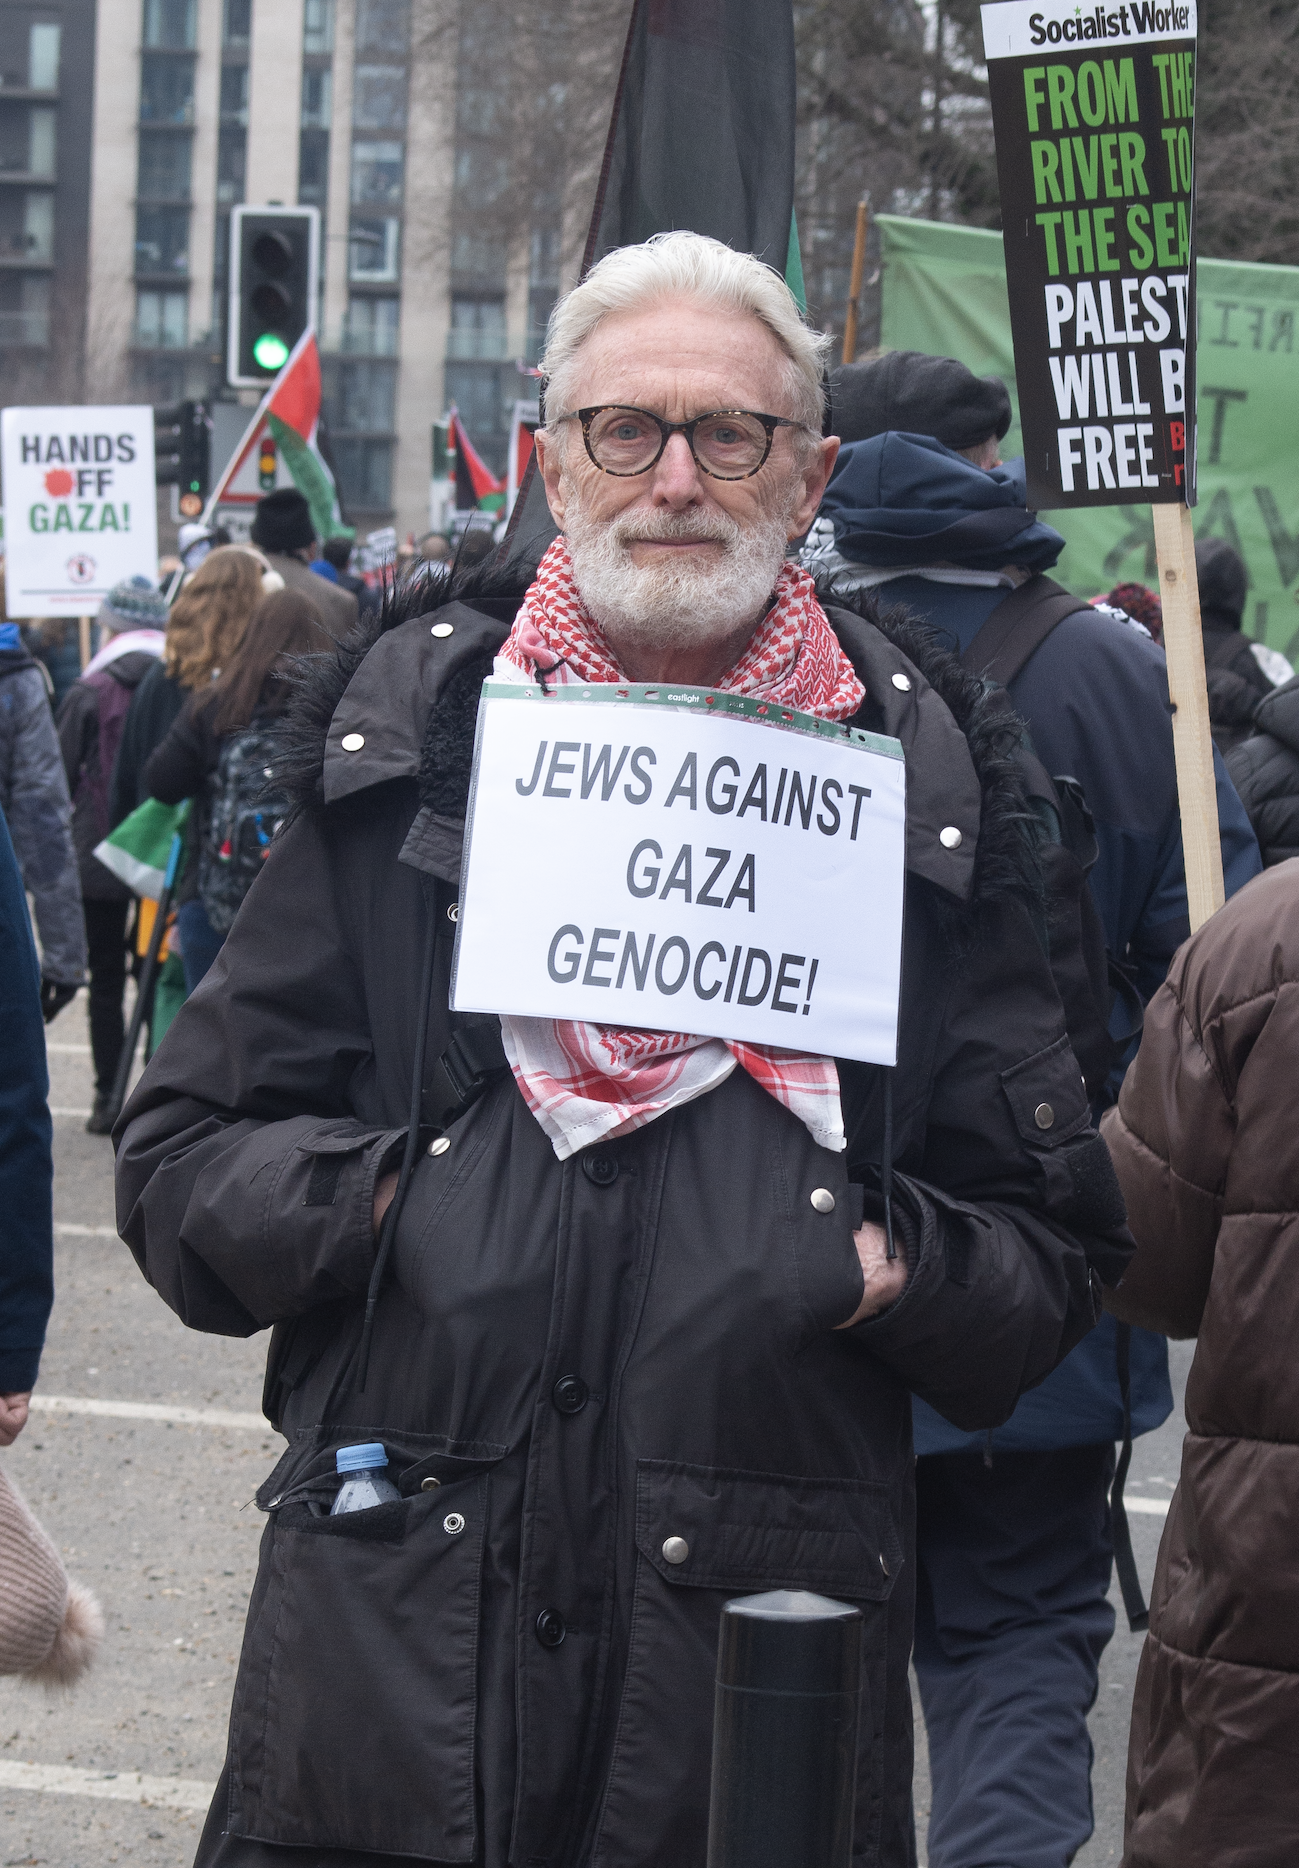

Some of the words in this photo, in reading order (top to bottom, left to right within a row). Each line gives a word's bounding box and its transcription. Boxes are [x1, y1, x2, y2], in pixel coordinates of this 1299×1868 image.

[1029, 5, 1131, 46] Socialist
[1129, 0, 1190, 35] Worker
[1023, 57, 1139, 132] FROM
[1152, 51, 1193, 119] THE
[1030, 132, 1149, 204] RIVER
[1161, 126, 1191, 193] TO
[1035, 207, 1120, 276] THE
[1126, 202, 1189, 271] SEA
[1044, 274, 1188, 348] PALEST
[1048, 351, 1150, 420] WILL
[1159, 348, 1185, 414] B
[20, 433, 136, 463] HANDS
[1057, 422, 1159, 492] FREE
[28, 502, 131, 533] GAZA!
[667, 693, 700, 704] eastlight
[515, 740, 657, 806] JEWS
[664, 751, 872, 842] AGAINST
[626, 838, 756, 913] GAZA
[547, 923, 819, 1016] GENOCIDE!
